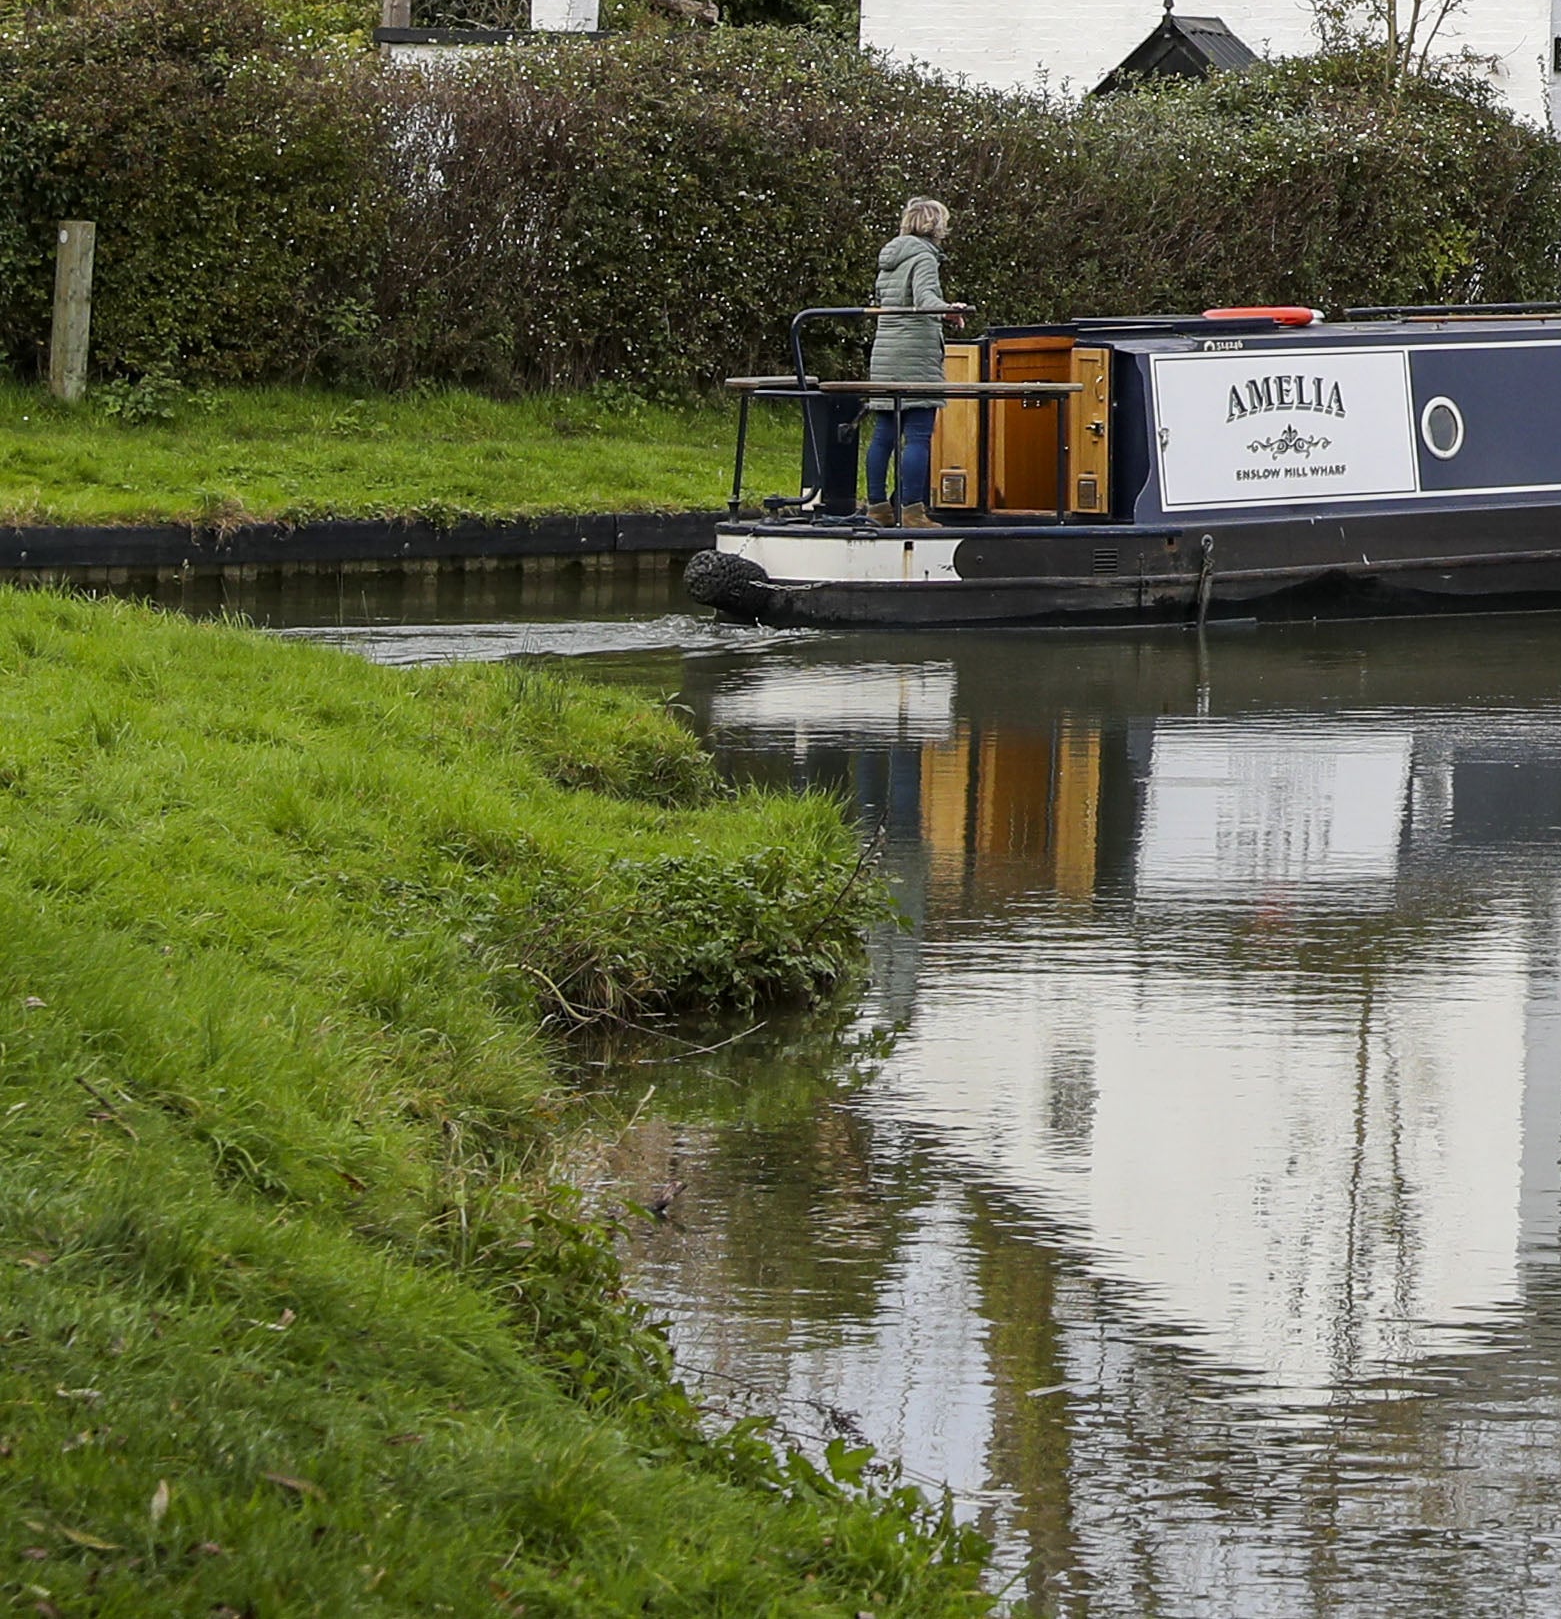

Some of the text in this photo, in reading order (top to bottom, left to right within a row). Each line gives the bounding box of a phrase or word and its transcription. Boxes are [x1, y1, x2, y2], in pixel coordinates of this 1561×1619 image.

[1226, 375, 1346, 423] AMELIA
[1236, 464, 1346, 481] ENSLOW MILL WHARF
